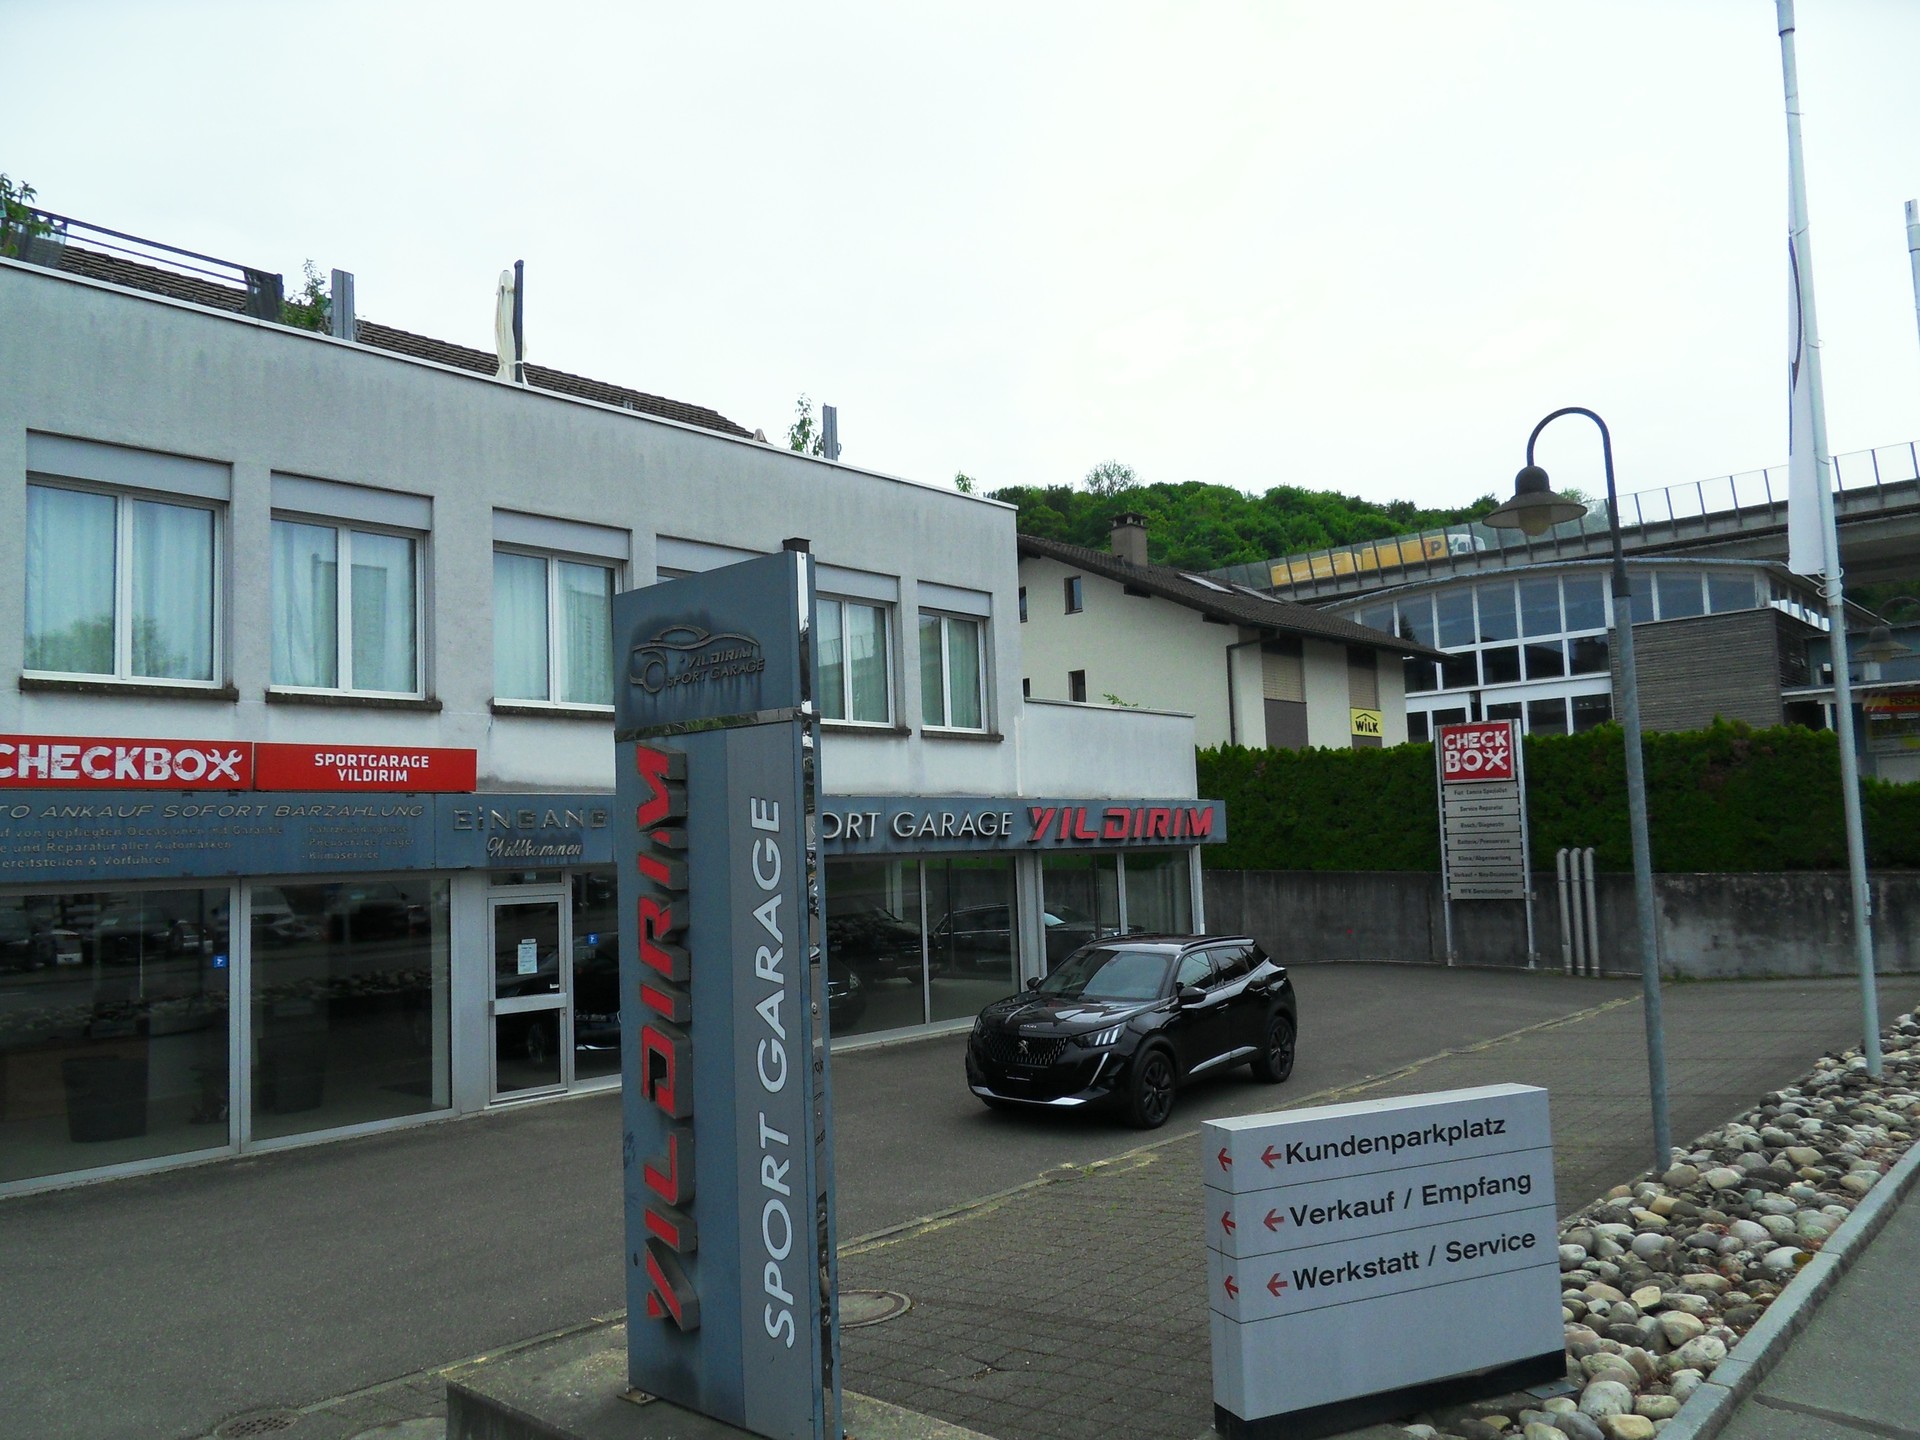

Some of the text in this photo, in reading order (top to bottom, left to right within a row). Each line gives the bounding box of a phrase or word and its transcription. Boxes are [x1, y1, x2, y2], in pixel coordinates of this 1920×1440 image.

[666, 658, 765, 687] SPORT GARAGE
[1444, 730, 1508, 750] CHECK
[314, 753, 430, 768] SPORTGARAGE
[337, 769, 408, 782] YILDIRIM
[40, 805, 154, 818] ANKAUF
[162, 804, 268, 818] SOFORT
[274, 805, 424, 817] BARZAHLUNG
[893, 811, 1013, 838] GARAGE
[1027, 807, 1213, 842] YILDIRIM
[486, 836, 583, 859] Willkommen
[751, 796, 796, 1350] SPORT GARAGE
[1286, 1116, 1506, 1165] Kundenparkplatz
[1290, 1173, 1532, 1227] Verkauf / Empfang
[1292, 1232, 1537, 1290] Werkstatt / Service
